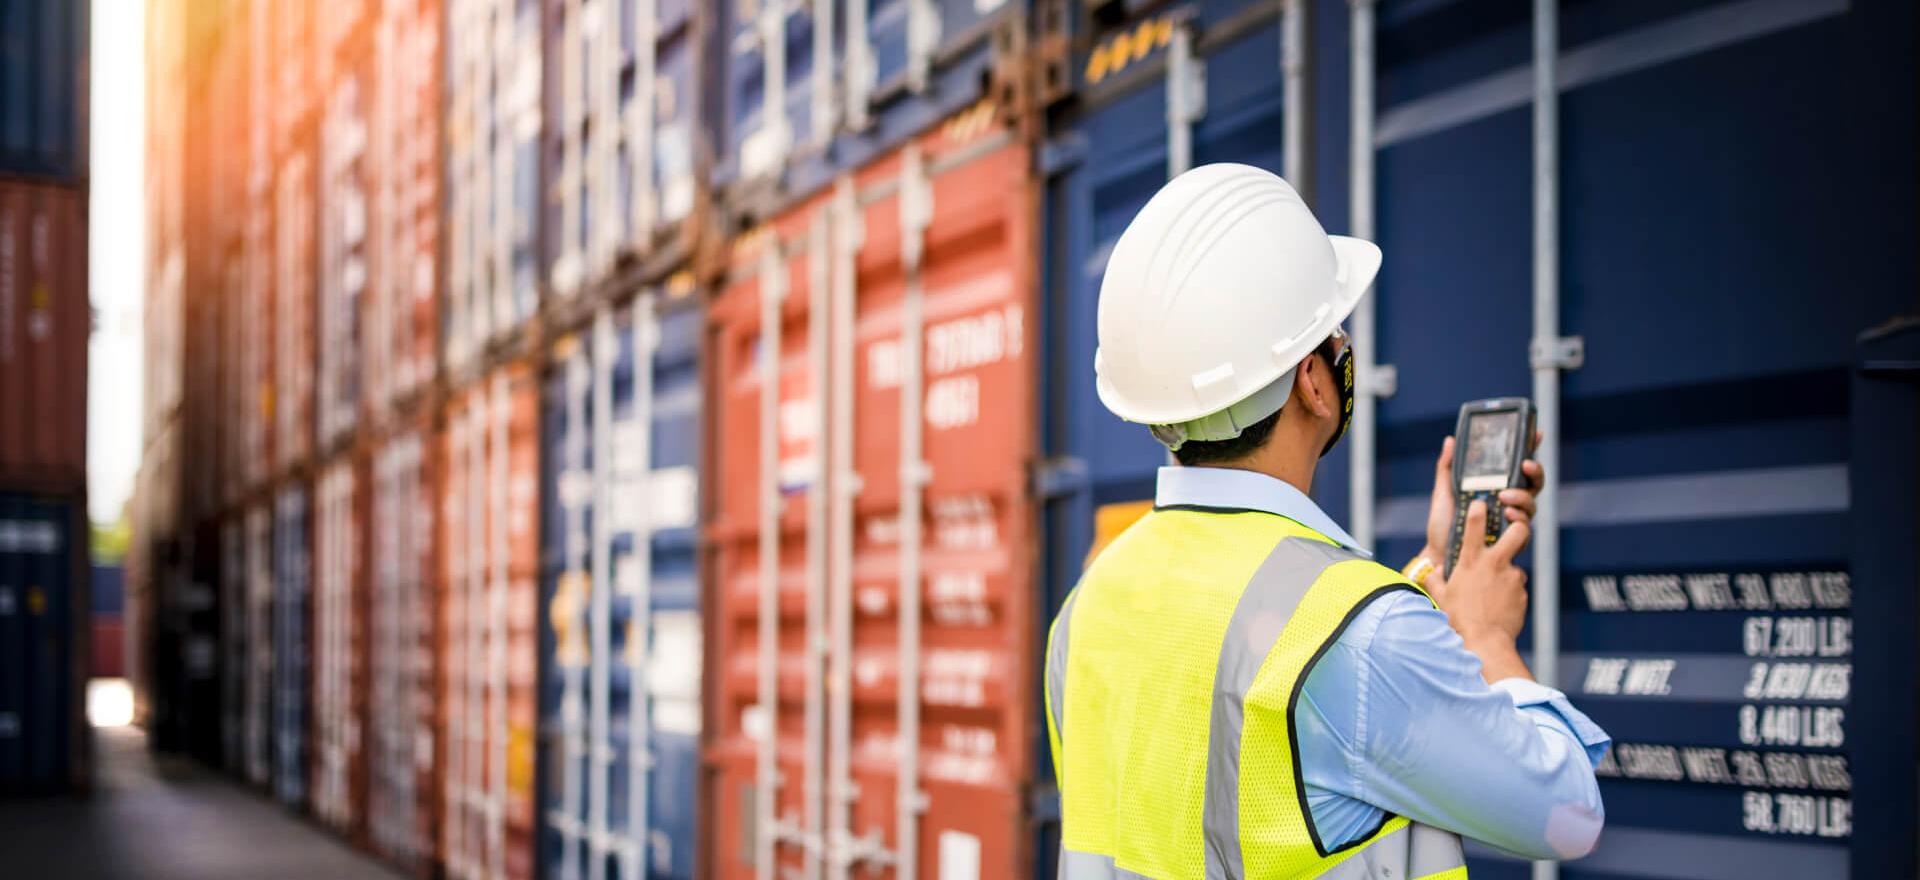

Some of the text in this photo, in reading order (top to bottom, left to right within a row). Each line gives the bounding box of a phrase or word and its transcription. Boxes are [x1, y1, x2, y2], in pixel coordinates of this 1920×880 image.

[1684, 573, 1739, 610] WGT.
[1744, 616, 1852, 657] 67,200 LB
[1739, 704, 1844, 747] 8,440 LBS
[1817, 796, 1852, 837] LB
